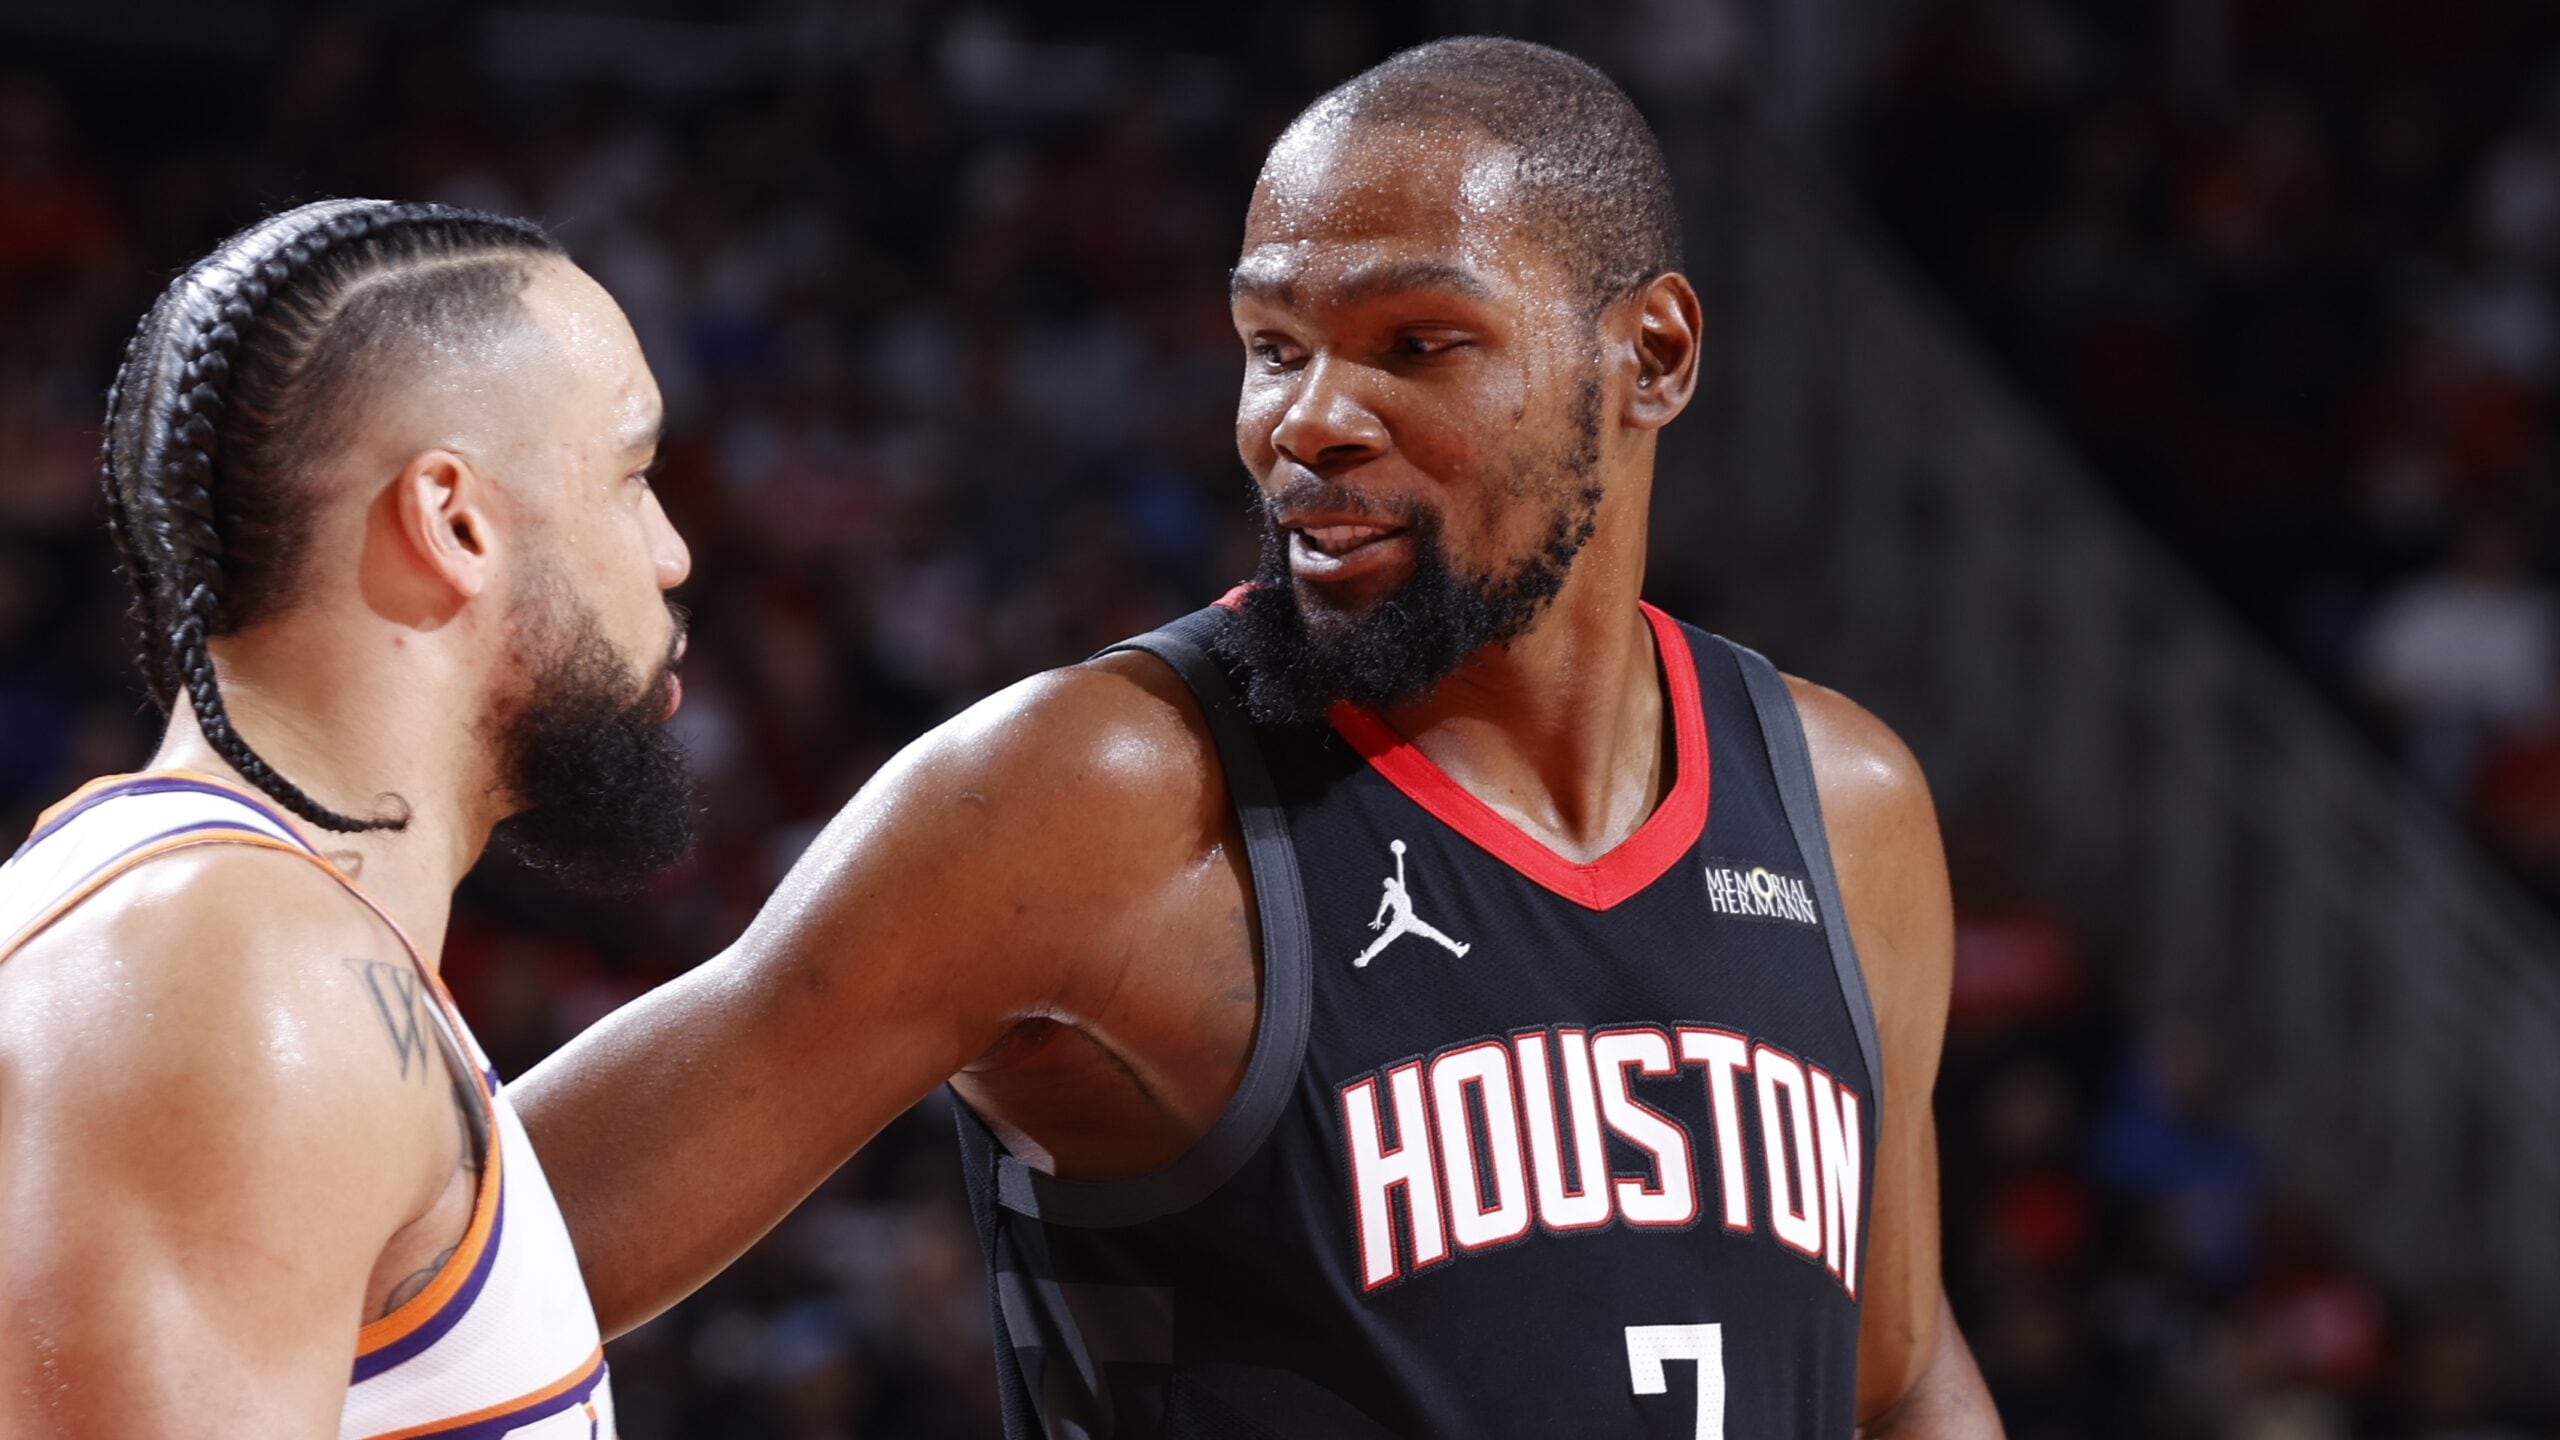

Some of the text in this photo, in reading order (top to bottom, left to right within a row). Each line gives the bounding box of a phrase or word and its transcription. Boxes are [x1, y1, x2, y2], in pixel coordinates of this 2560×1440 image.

[1705, 867, 1813, 904] MEMORIAL
[1708, 887, 1818, 924] HERMANN
[1340, 1026, 1861, 1302] HOUSTON
[1625, 1323, 1725, 1440] 7
